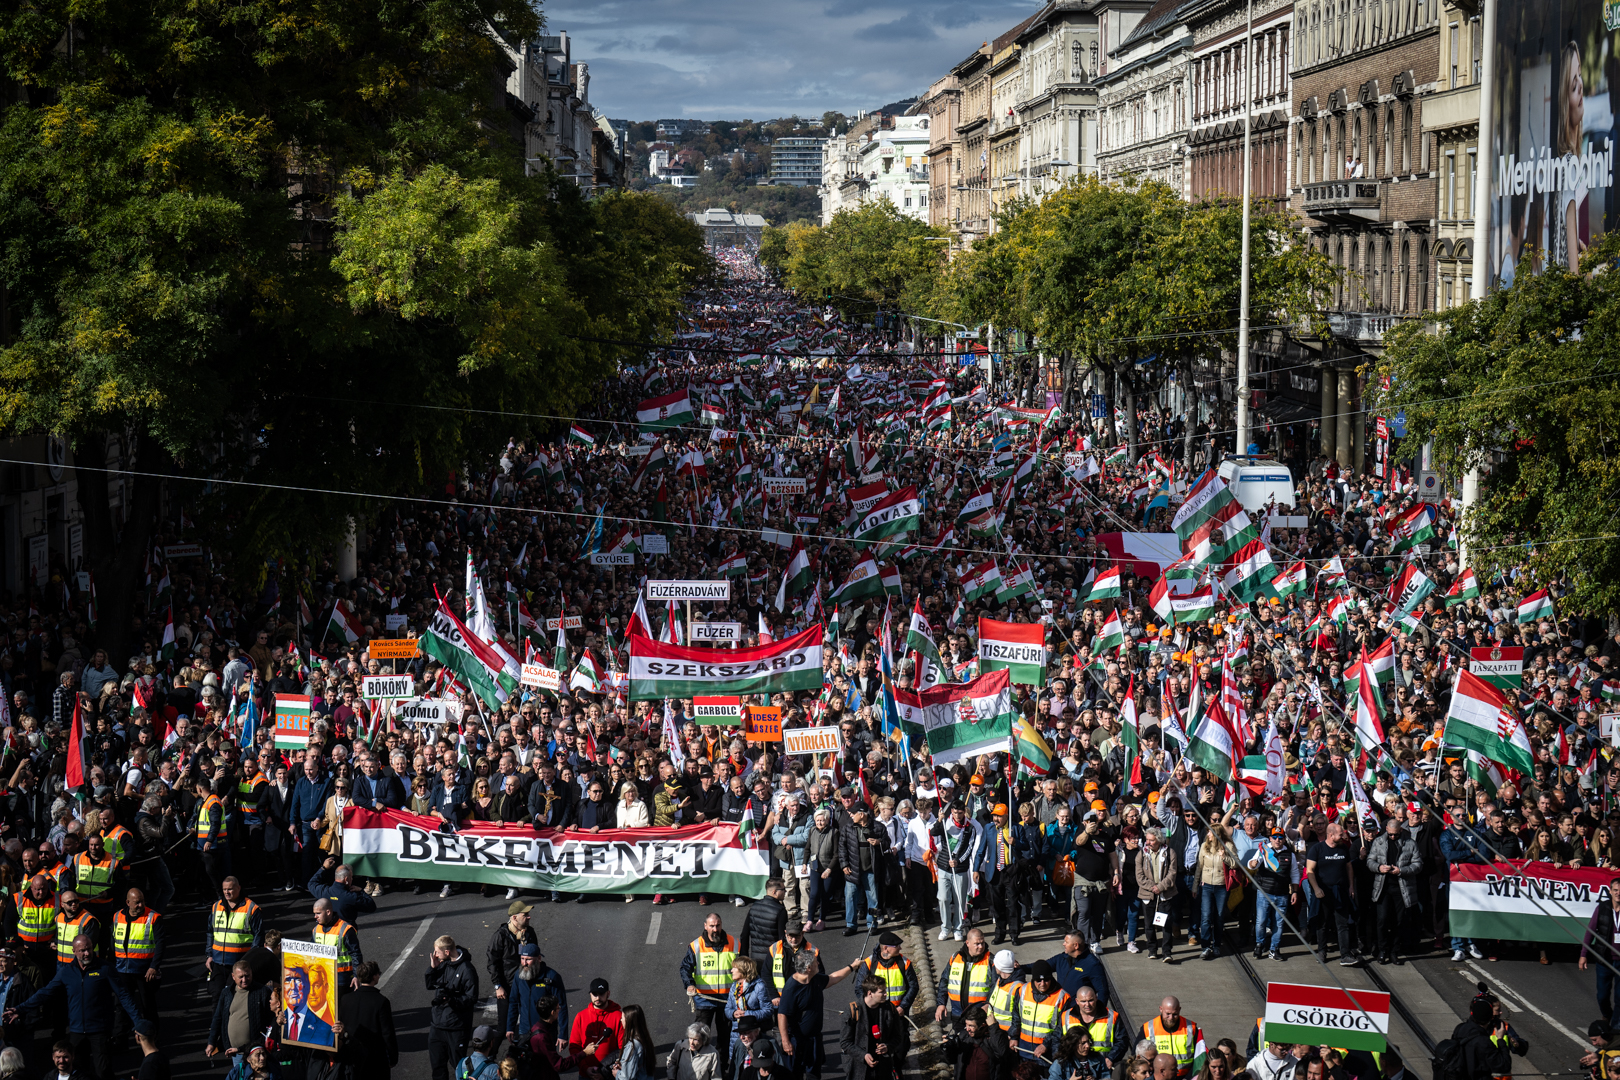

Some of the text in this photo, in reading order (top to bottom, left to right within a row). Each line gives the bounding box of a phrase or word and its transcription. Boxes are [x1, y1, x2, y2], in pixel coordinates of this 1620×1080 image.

[1499, 136, 1613, 203] Merj álmodni!
[167, 547, 201, 556] Debrecen
[595, 554, 630, 564] GYÜRE
[650, 584, 727, 597] FÜZÉRRADVÁNY
[548, 616, 581, 630] CSRNA
[697, 625, 734, 638] FÜZÉR
[377, 650, 412, 658] NYÍRMADA
[647, 651, 807, 678] SZEKSZÁRD
[524, 666, 557, 680] ACSALAG
[368, 678, 408, 696] BÖKÖNY
[402, 706, 439, 719] KOMLÓ
[697, 706, 737, 716] GARBOLC
[749, 713, 778, 721] FIDESZ
[277, 715, 309, 731] BÉKE
[787, 730, 838, 752] NYÍRKÁTA
[702, 960, 715, 968] 587
[1283, 1008, 1371, 1031] CSÖRÖG
